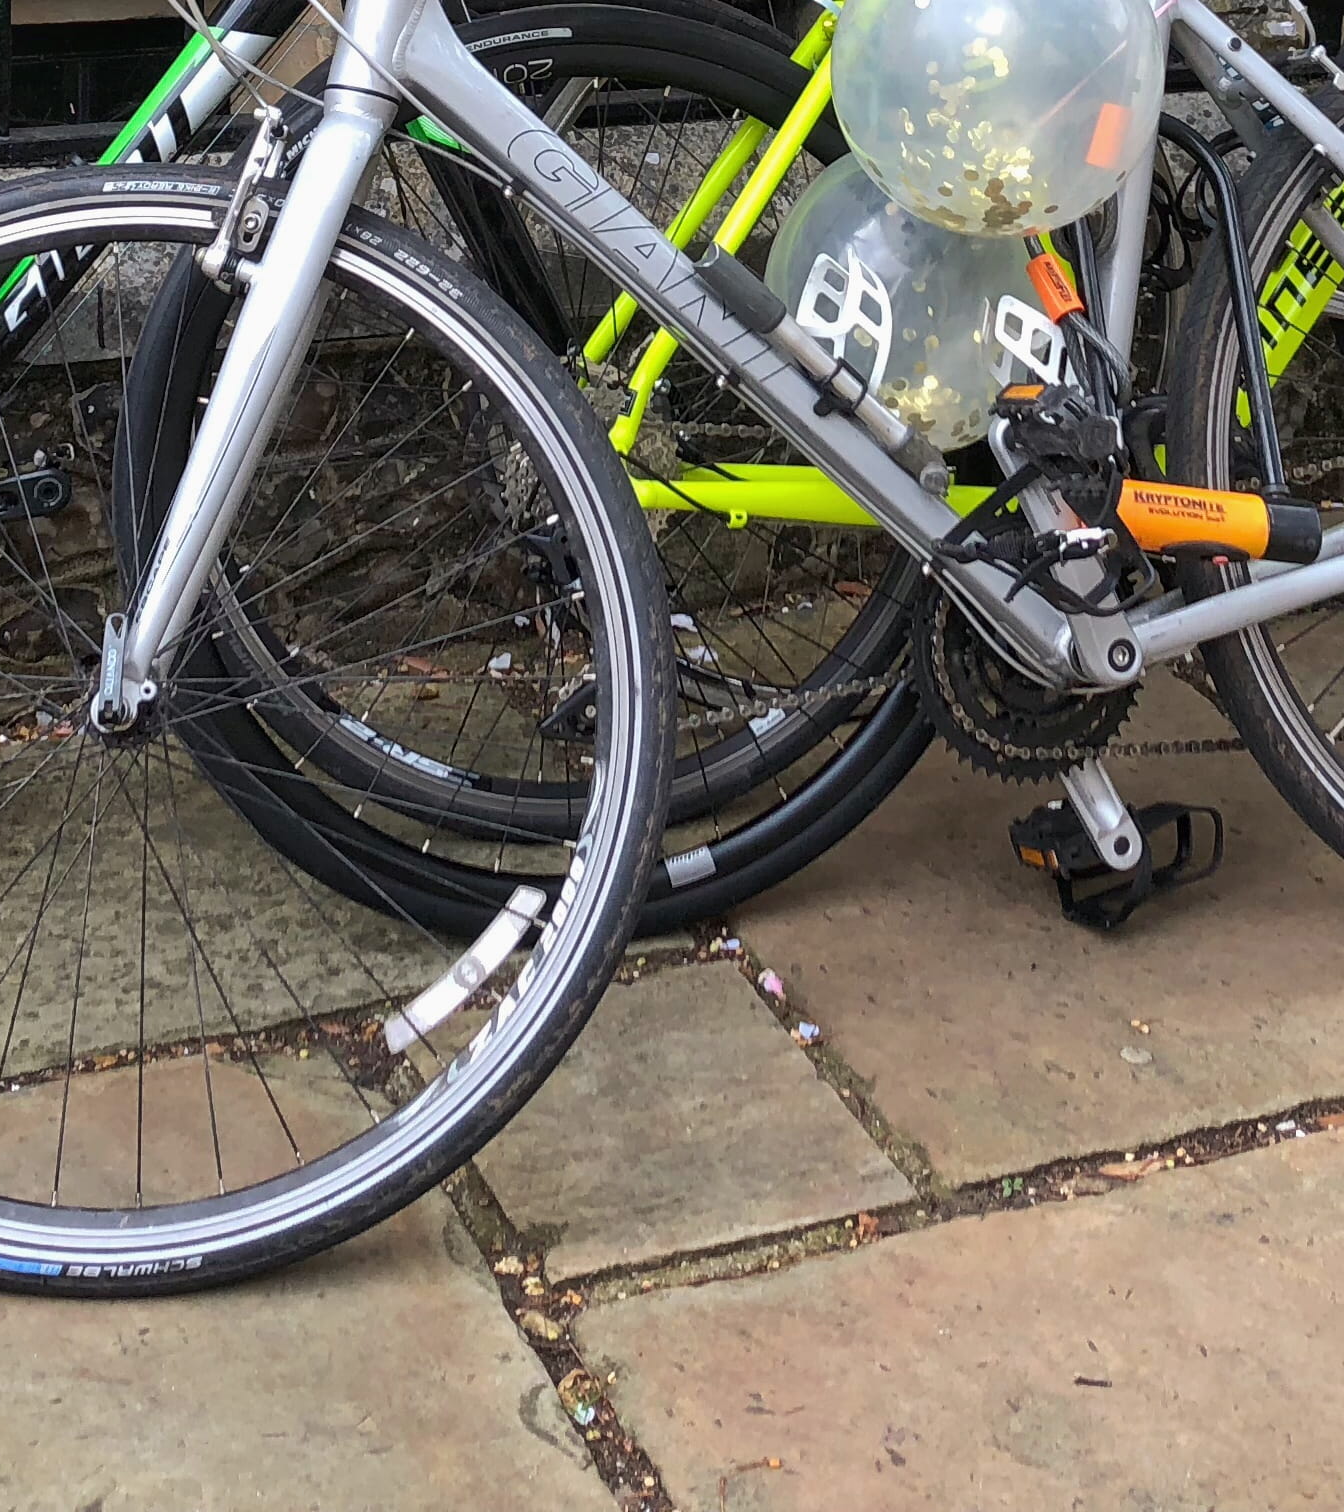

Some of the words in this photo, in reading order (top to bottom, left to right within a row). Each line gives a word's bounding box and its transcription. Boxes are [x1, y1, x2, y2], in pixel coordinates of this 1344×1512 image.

[503, 117, 810, 381] GIANT
[395, 249, 463, 300] 32-622
[1134, 490, 1226, 514] KRYPTONITE
[67, 1256, 202, 1276] SCHWALBE
